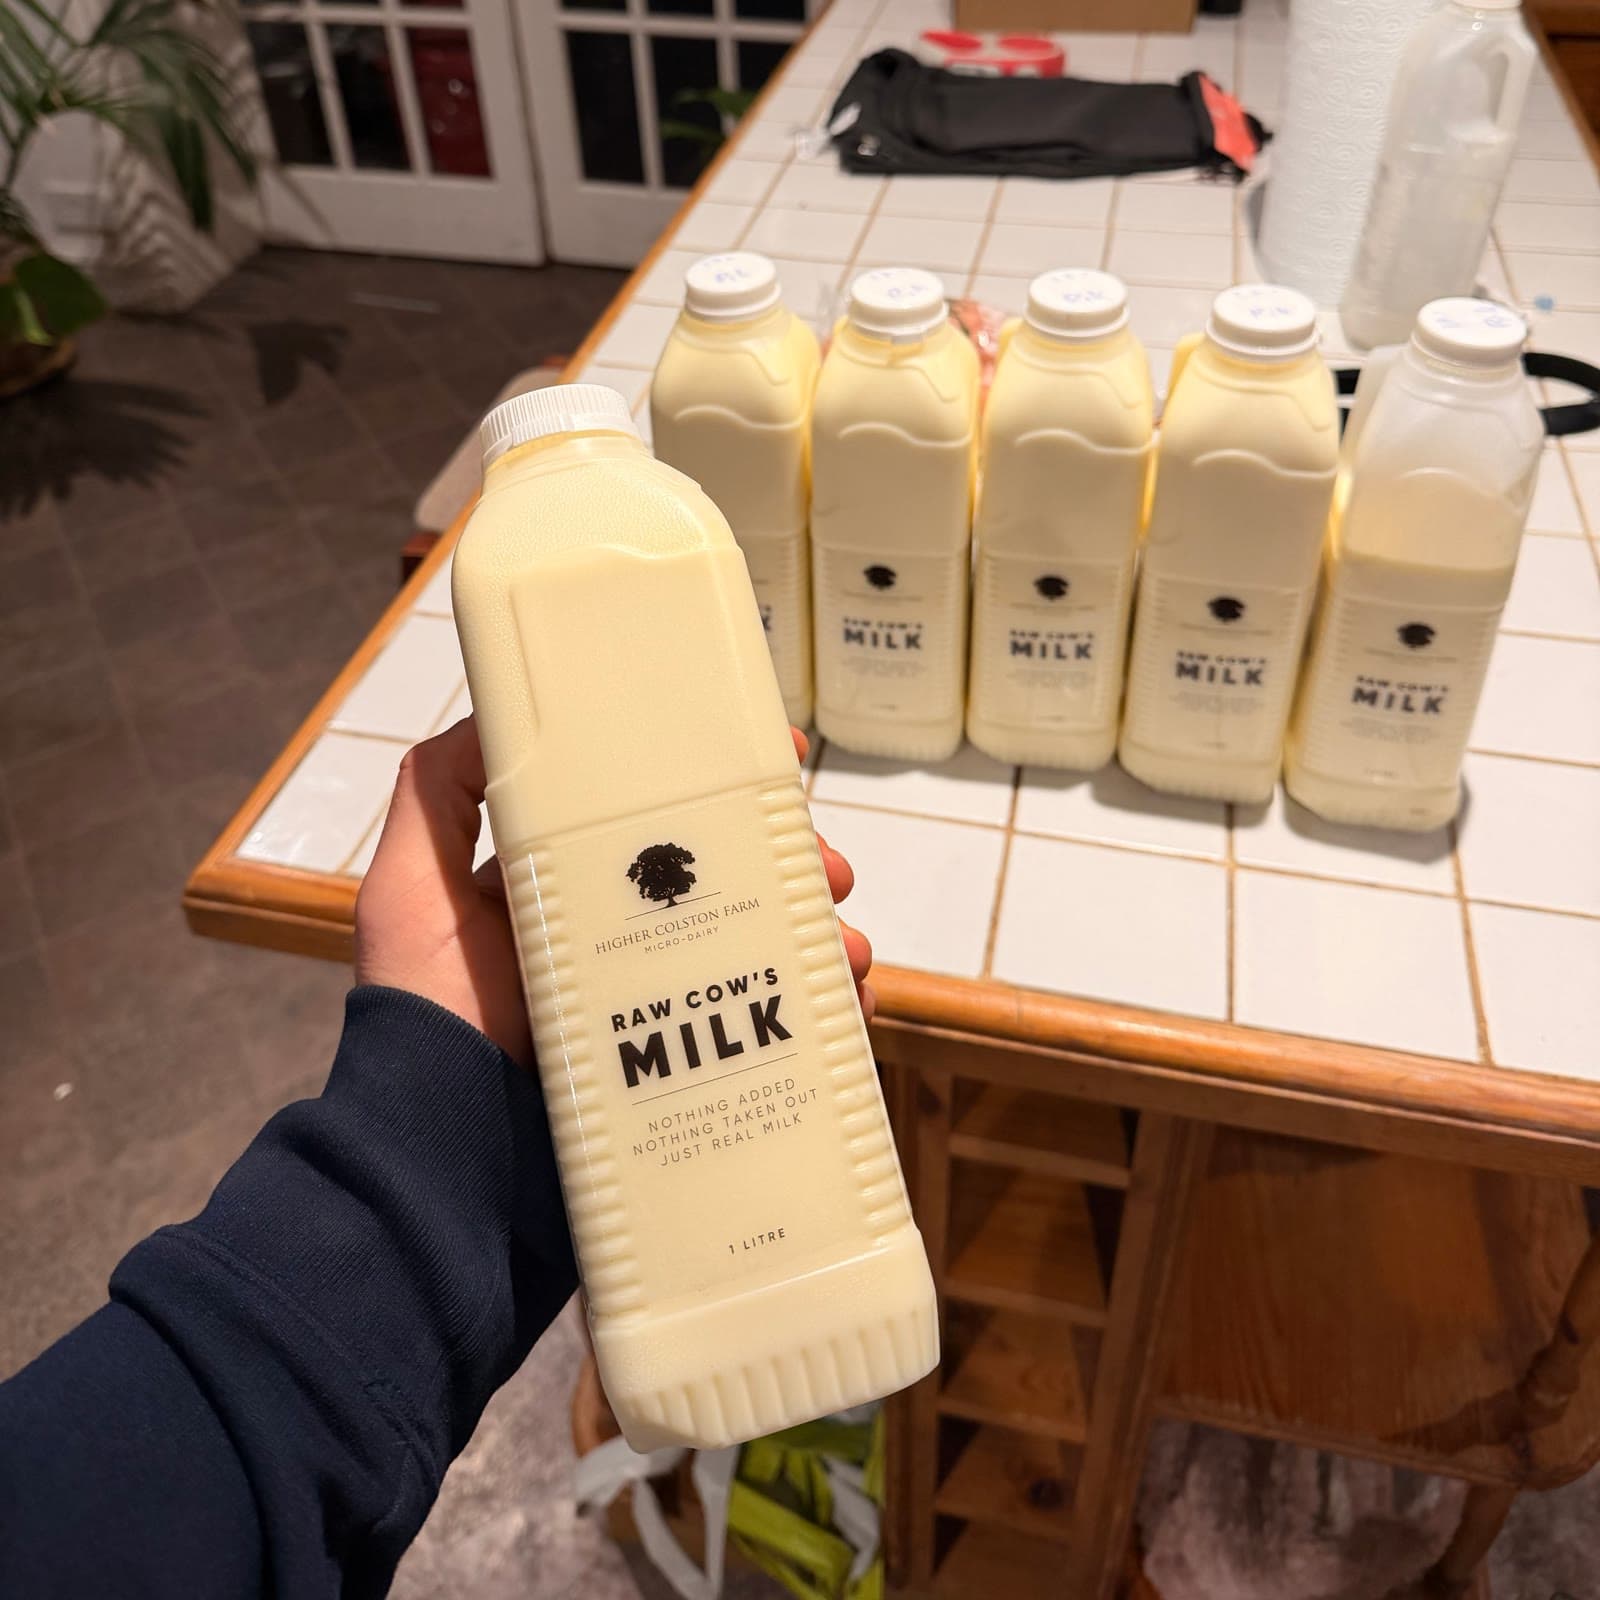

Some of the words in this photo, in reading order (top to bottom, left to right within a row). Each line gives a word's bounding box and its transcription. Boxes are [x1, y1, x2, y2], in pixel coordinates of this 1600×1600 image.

[843, 627, 922, 651] MILK
[1009, 639, 1092, 661] MILK
[1175, 660, 1264, 686] MILK
[1351, 686, 1444, 715] MILK
[595, 928, 652, 954] HIGHER
[654, 909, 721, 937] COLSTON
[724, 898, 760, 917] FARM
[644, 926, 720, 953] MICRO-DAIRY
[611, 999, 671, 1032] RAW
[685, 967, 779, 1009] COW'S
[618, 994, 793, 1088] MILK
[632, 1122, 714, 1156] NOTHING
[723, 1102, 776, 1128] TAKEN
[785, 1088, 817, 1108] OUT
[648, 1099, 729, 1133] NOTHING
[739, 1078, 795, 1106] ADDED
[661, 1144, 702, 1166] JUST
[712, 1129, 754, 1150] REAL
[763, 1112, 802, 1134] MILK
[729, 1244, 735, 1254] 1
[743, 1228, 786, 1250] LITRE
